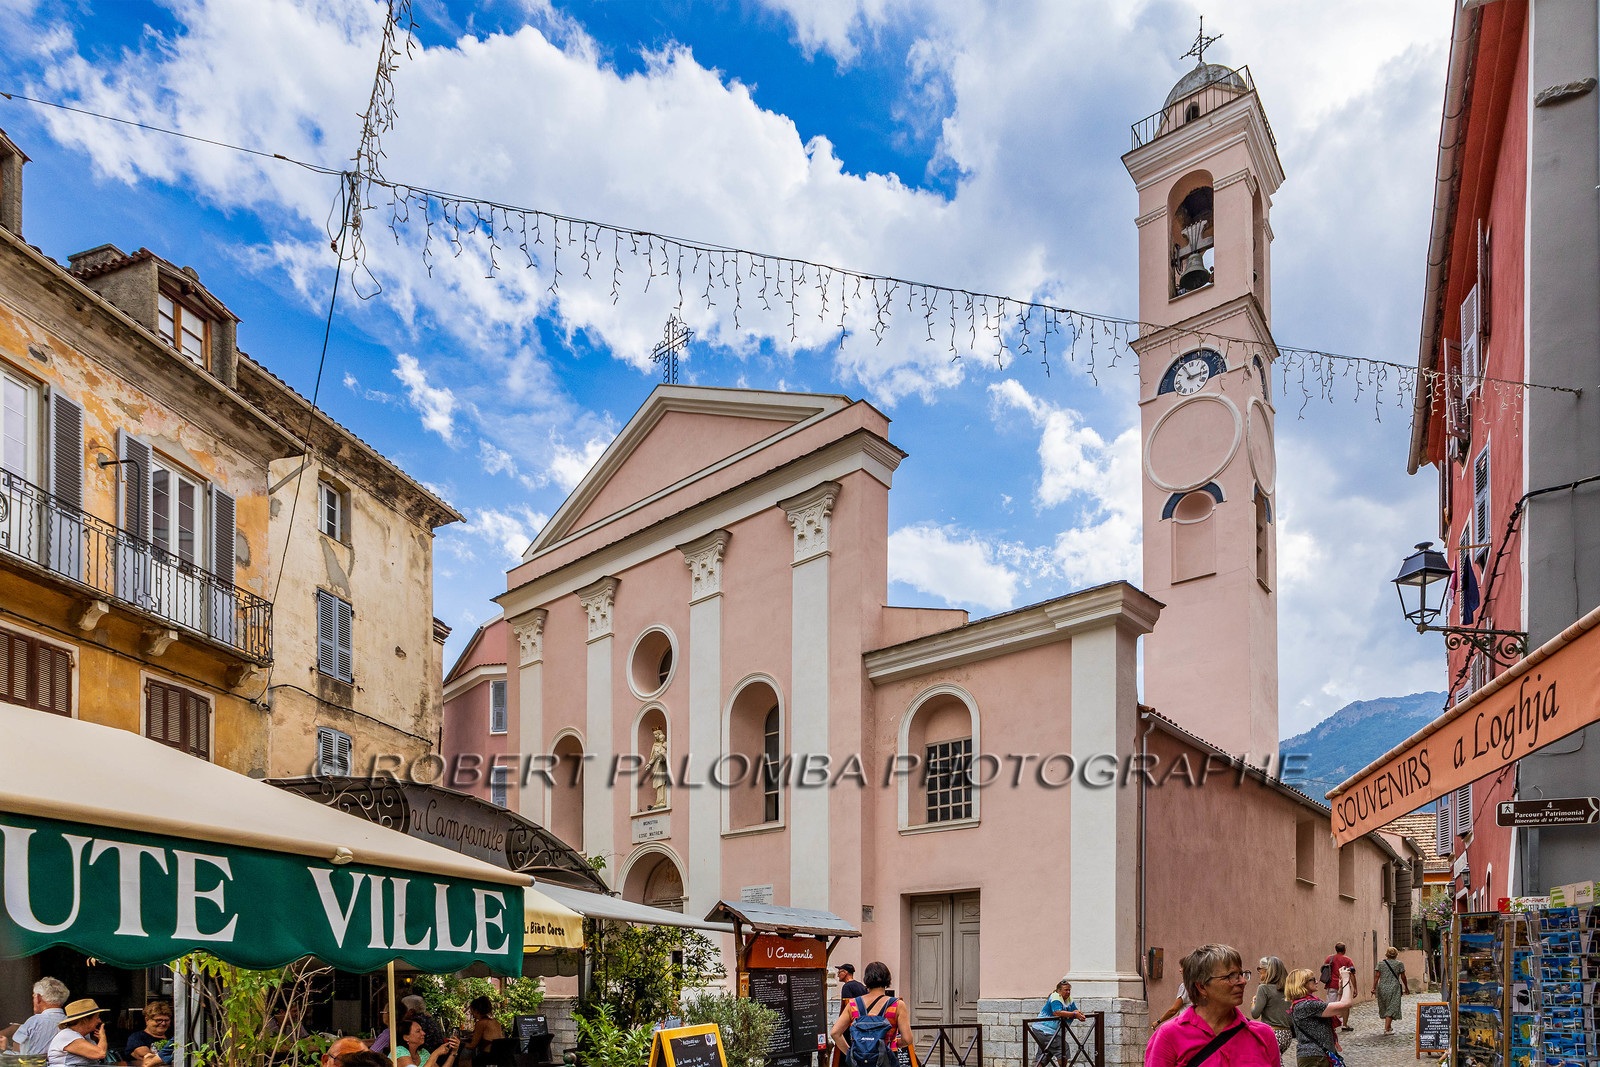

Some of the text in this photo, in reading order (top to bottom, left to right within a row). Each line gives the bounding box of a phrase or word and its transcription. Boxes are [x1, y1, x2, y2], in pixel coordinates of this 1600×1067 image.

[1337, 674, 1560, 833] SOUVENIRS a Loghja
[1545, 809, 1584, 817] Patrimonial
[1546, 801, 1553, 809] 4
[426, 799, 504, 853] Campanile
[0, 824, 510, 955] UTE VILLE
[775, 946, 814, 962] Campanile
